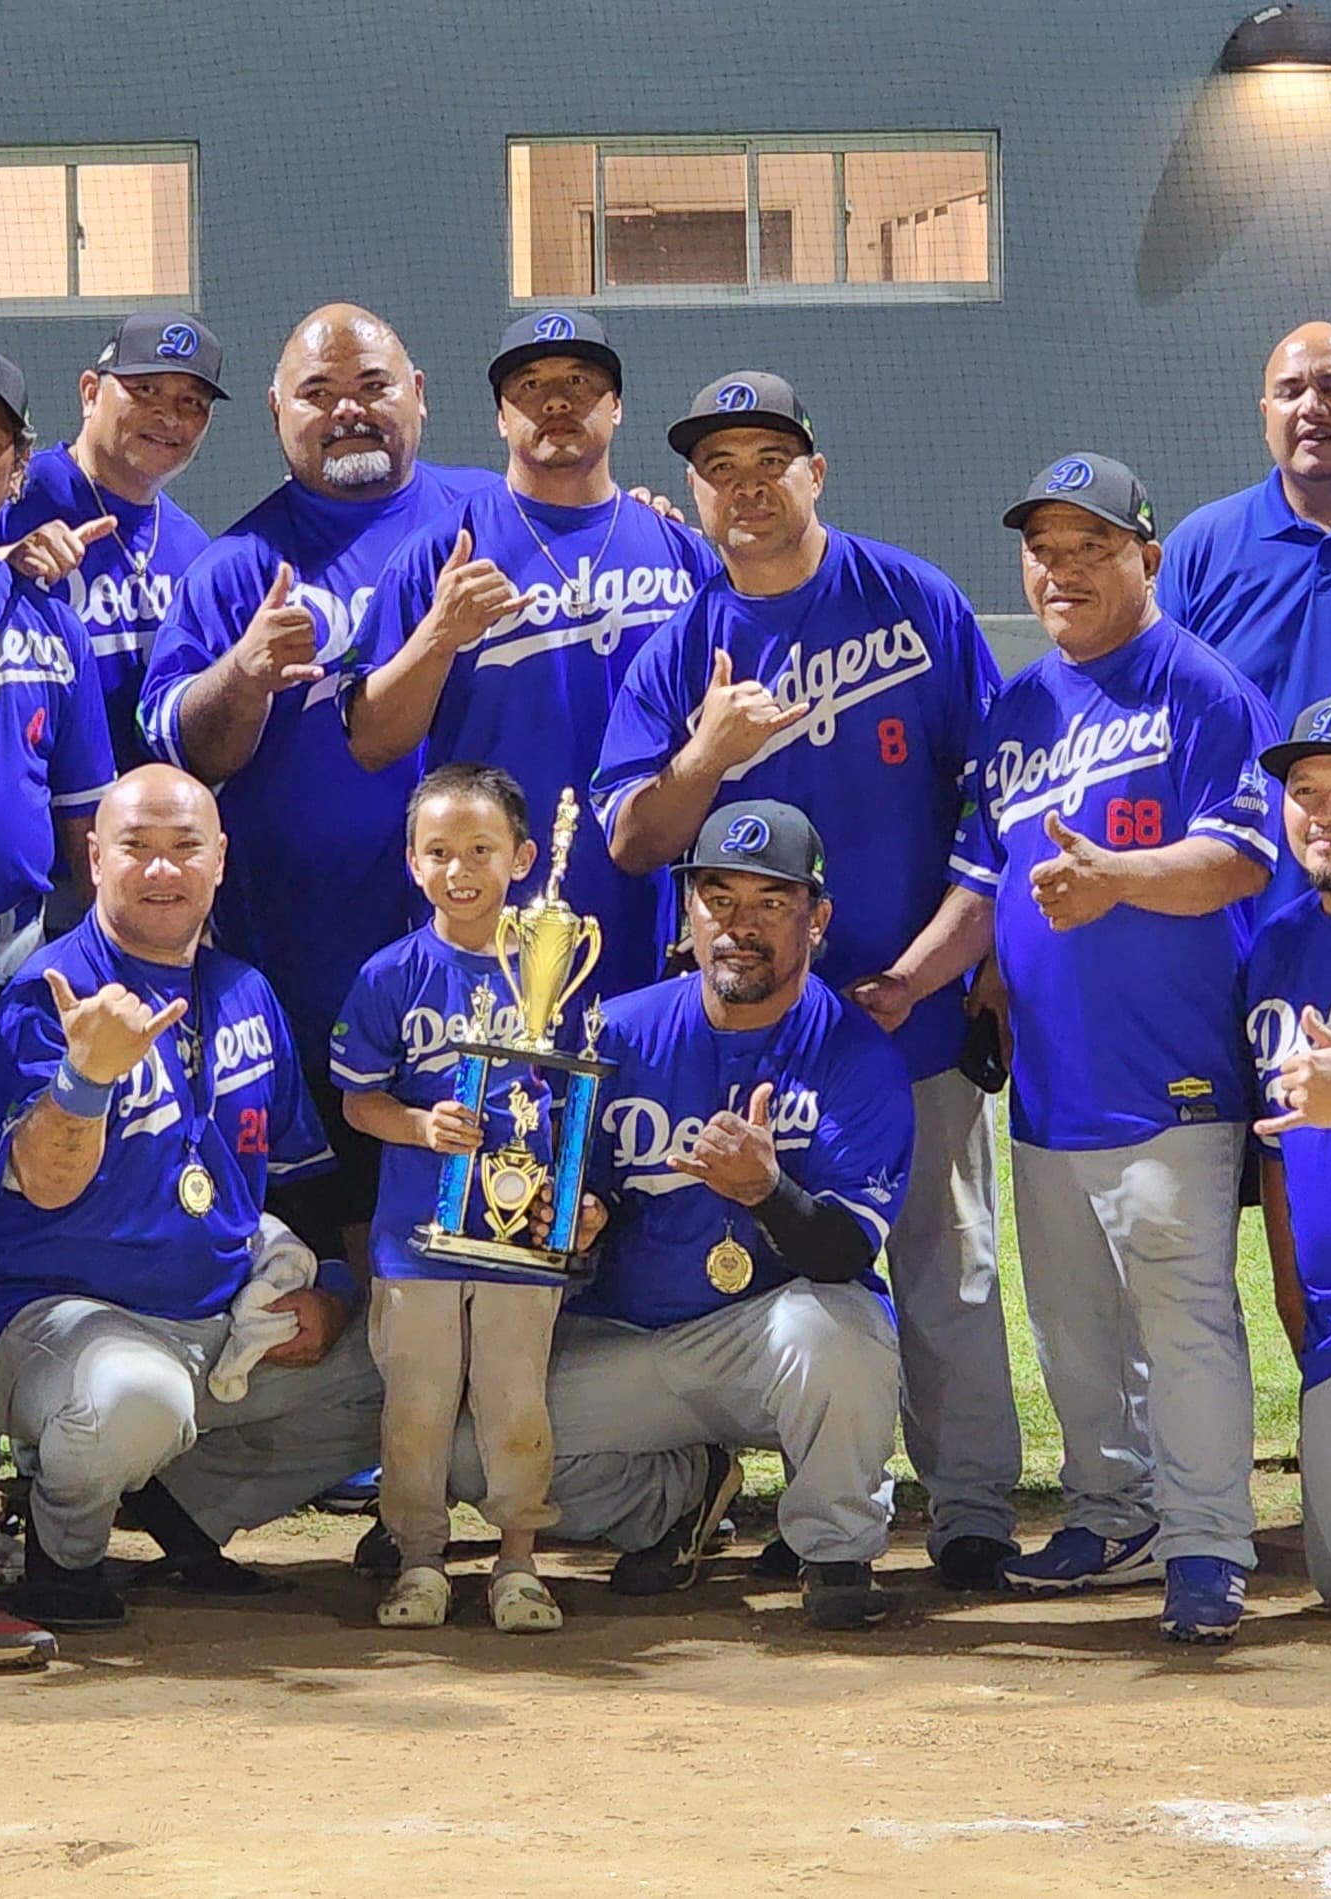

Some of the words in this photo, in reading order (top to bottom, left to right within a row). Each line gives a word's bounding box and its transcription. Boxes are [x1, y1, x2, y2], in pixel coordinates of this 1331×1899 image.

[157, 323, 200, 359] D
[533, 312, 577, 345] D
[715, 381, 758, 414] D
[1046, 457, 1095, 495] D
[878, 719, 908, 764] 8
[986, 706, 1172, 820] Dodgers
[720, 814, 771, 855] D
[1106, 798, 1162, 846] 68
